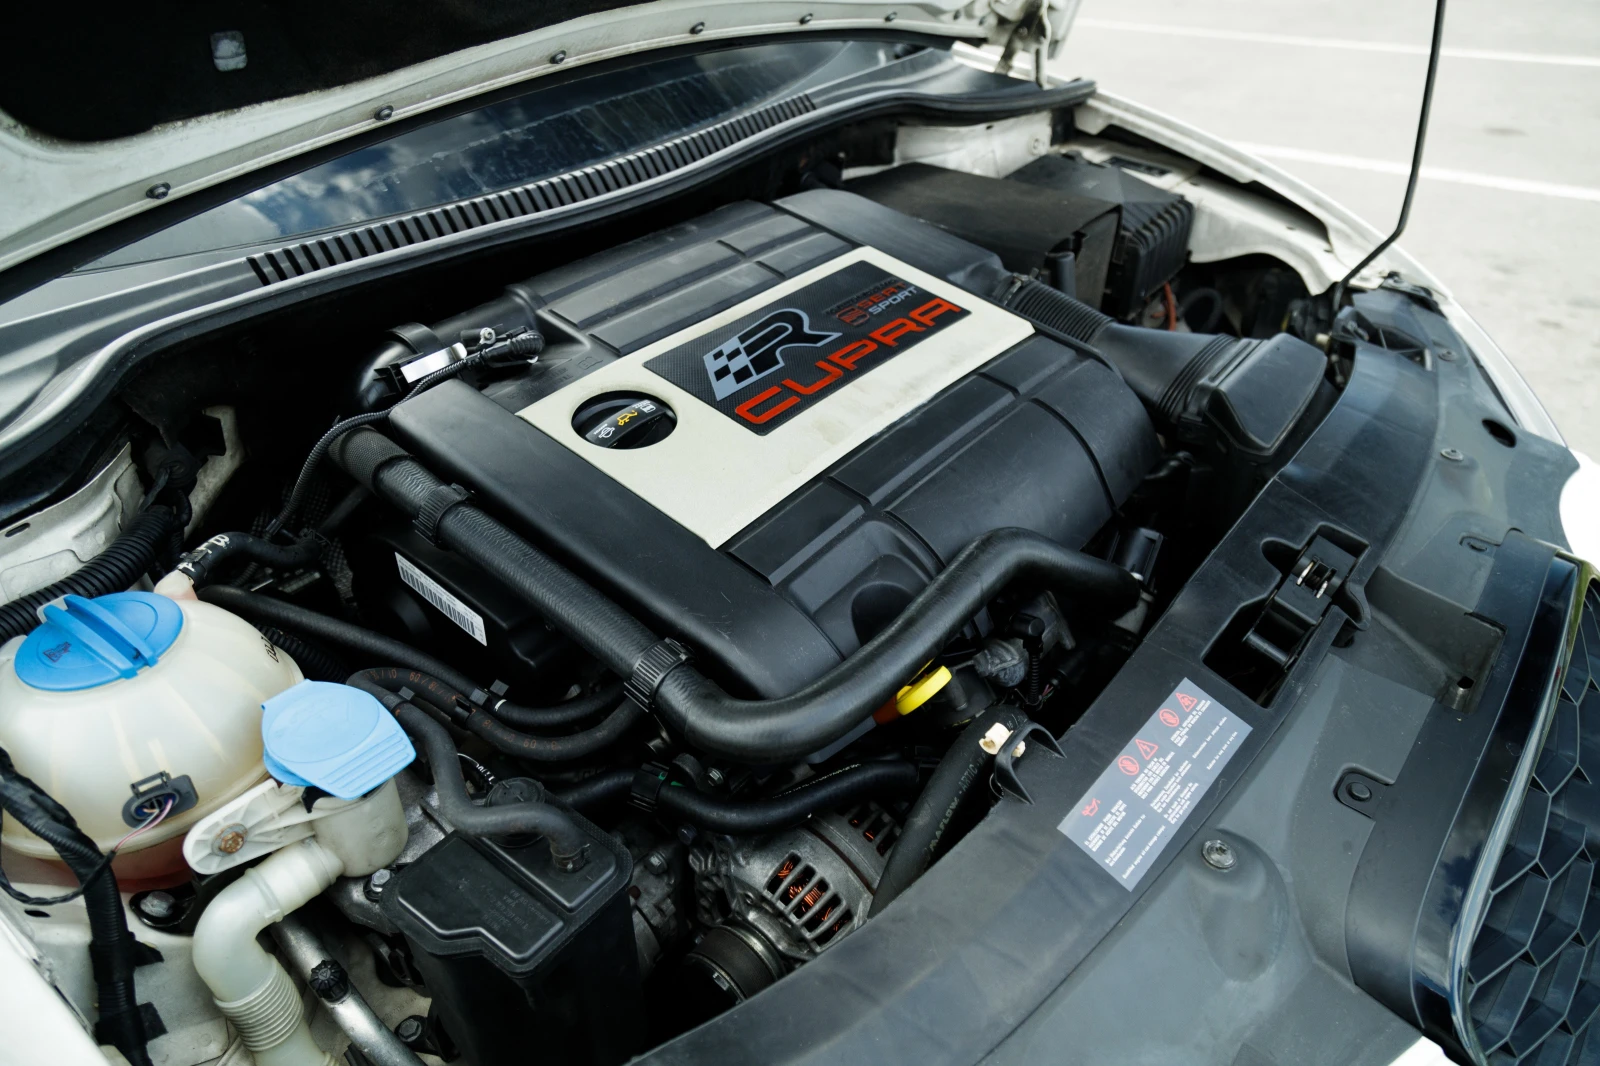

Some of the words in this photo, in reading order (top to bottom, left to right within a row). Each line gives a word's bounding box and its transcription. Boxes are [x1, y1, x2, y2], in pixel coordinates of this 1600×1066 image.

[857, 281, 907, 309] SEAT
[868, 286, 918, 316] SPORT
[734, 297, 963, 425] CUPRA
